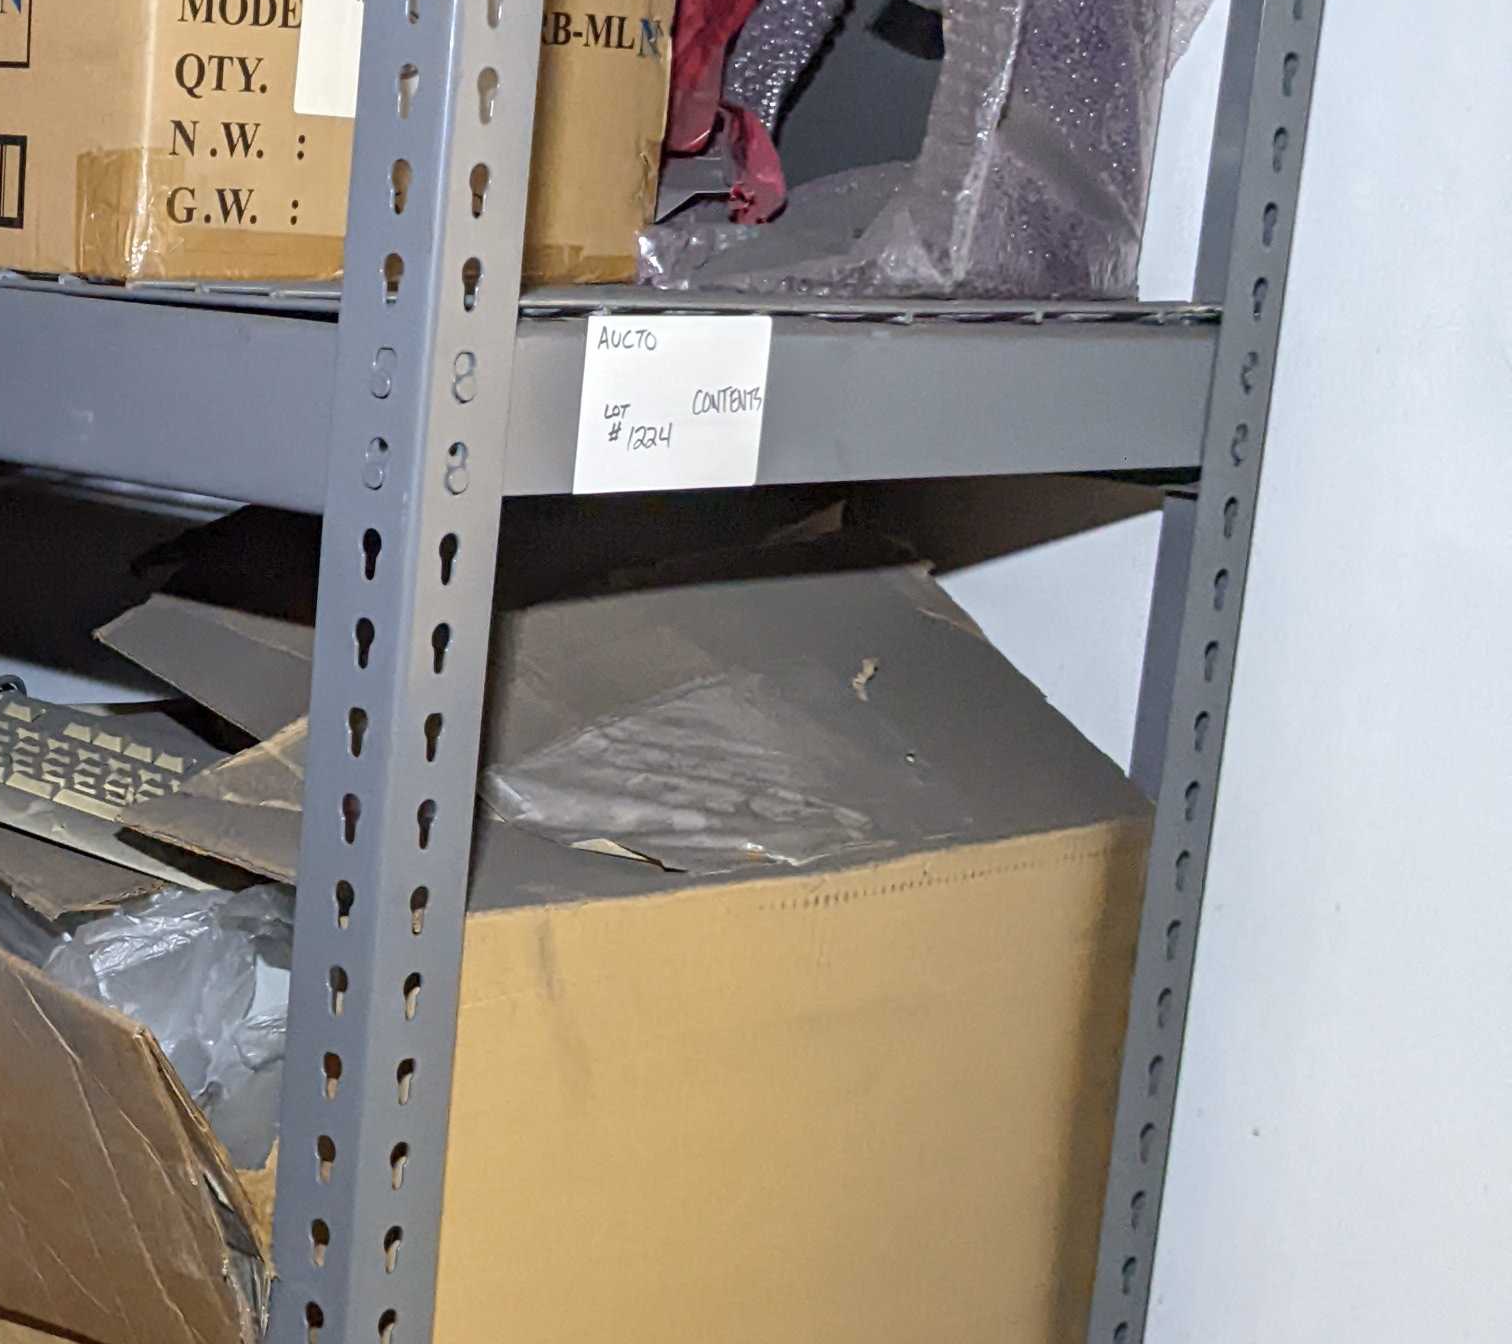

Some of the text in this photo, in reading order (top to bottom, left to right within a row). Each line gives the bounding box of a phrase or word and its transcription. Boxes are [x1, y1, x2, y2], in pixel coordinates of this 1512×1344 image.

[174, 52, 267, 100] QTY.
[597, 325, 658, 351] AUCTO
[603, 403, 631, 420] LOT
[691, 385, 762, 416] CONTENTS
